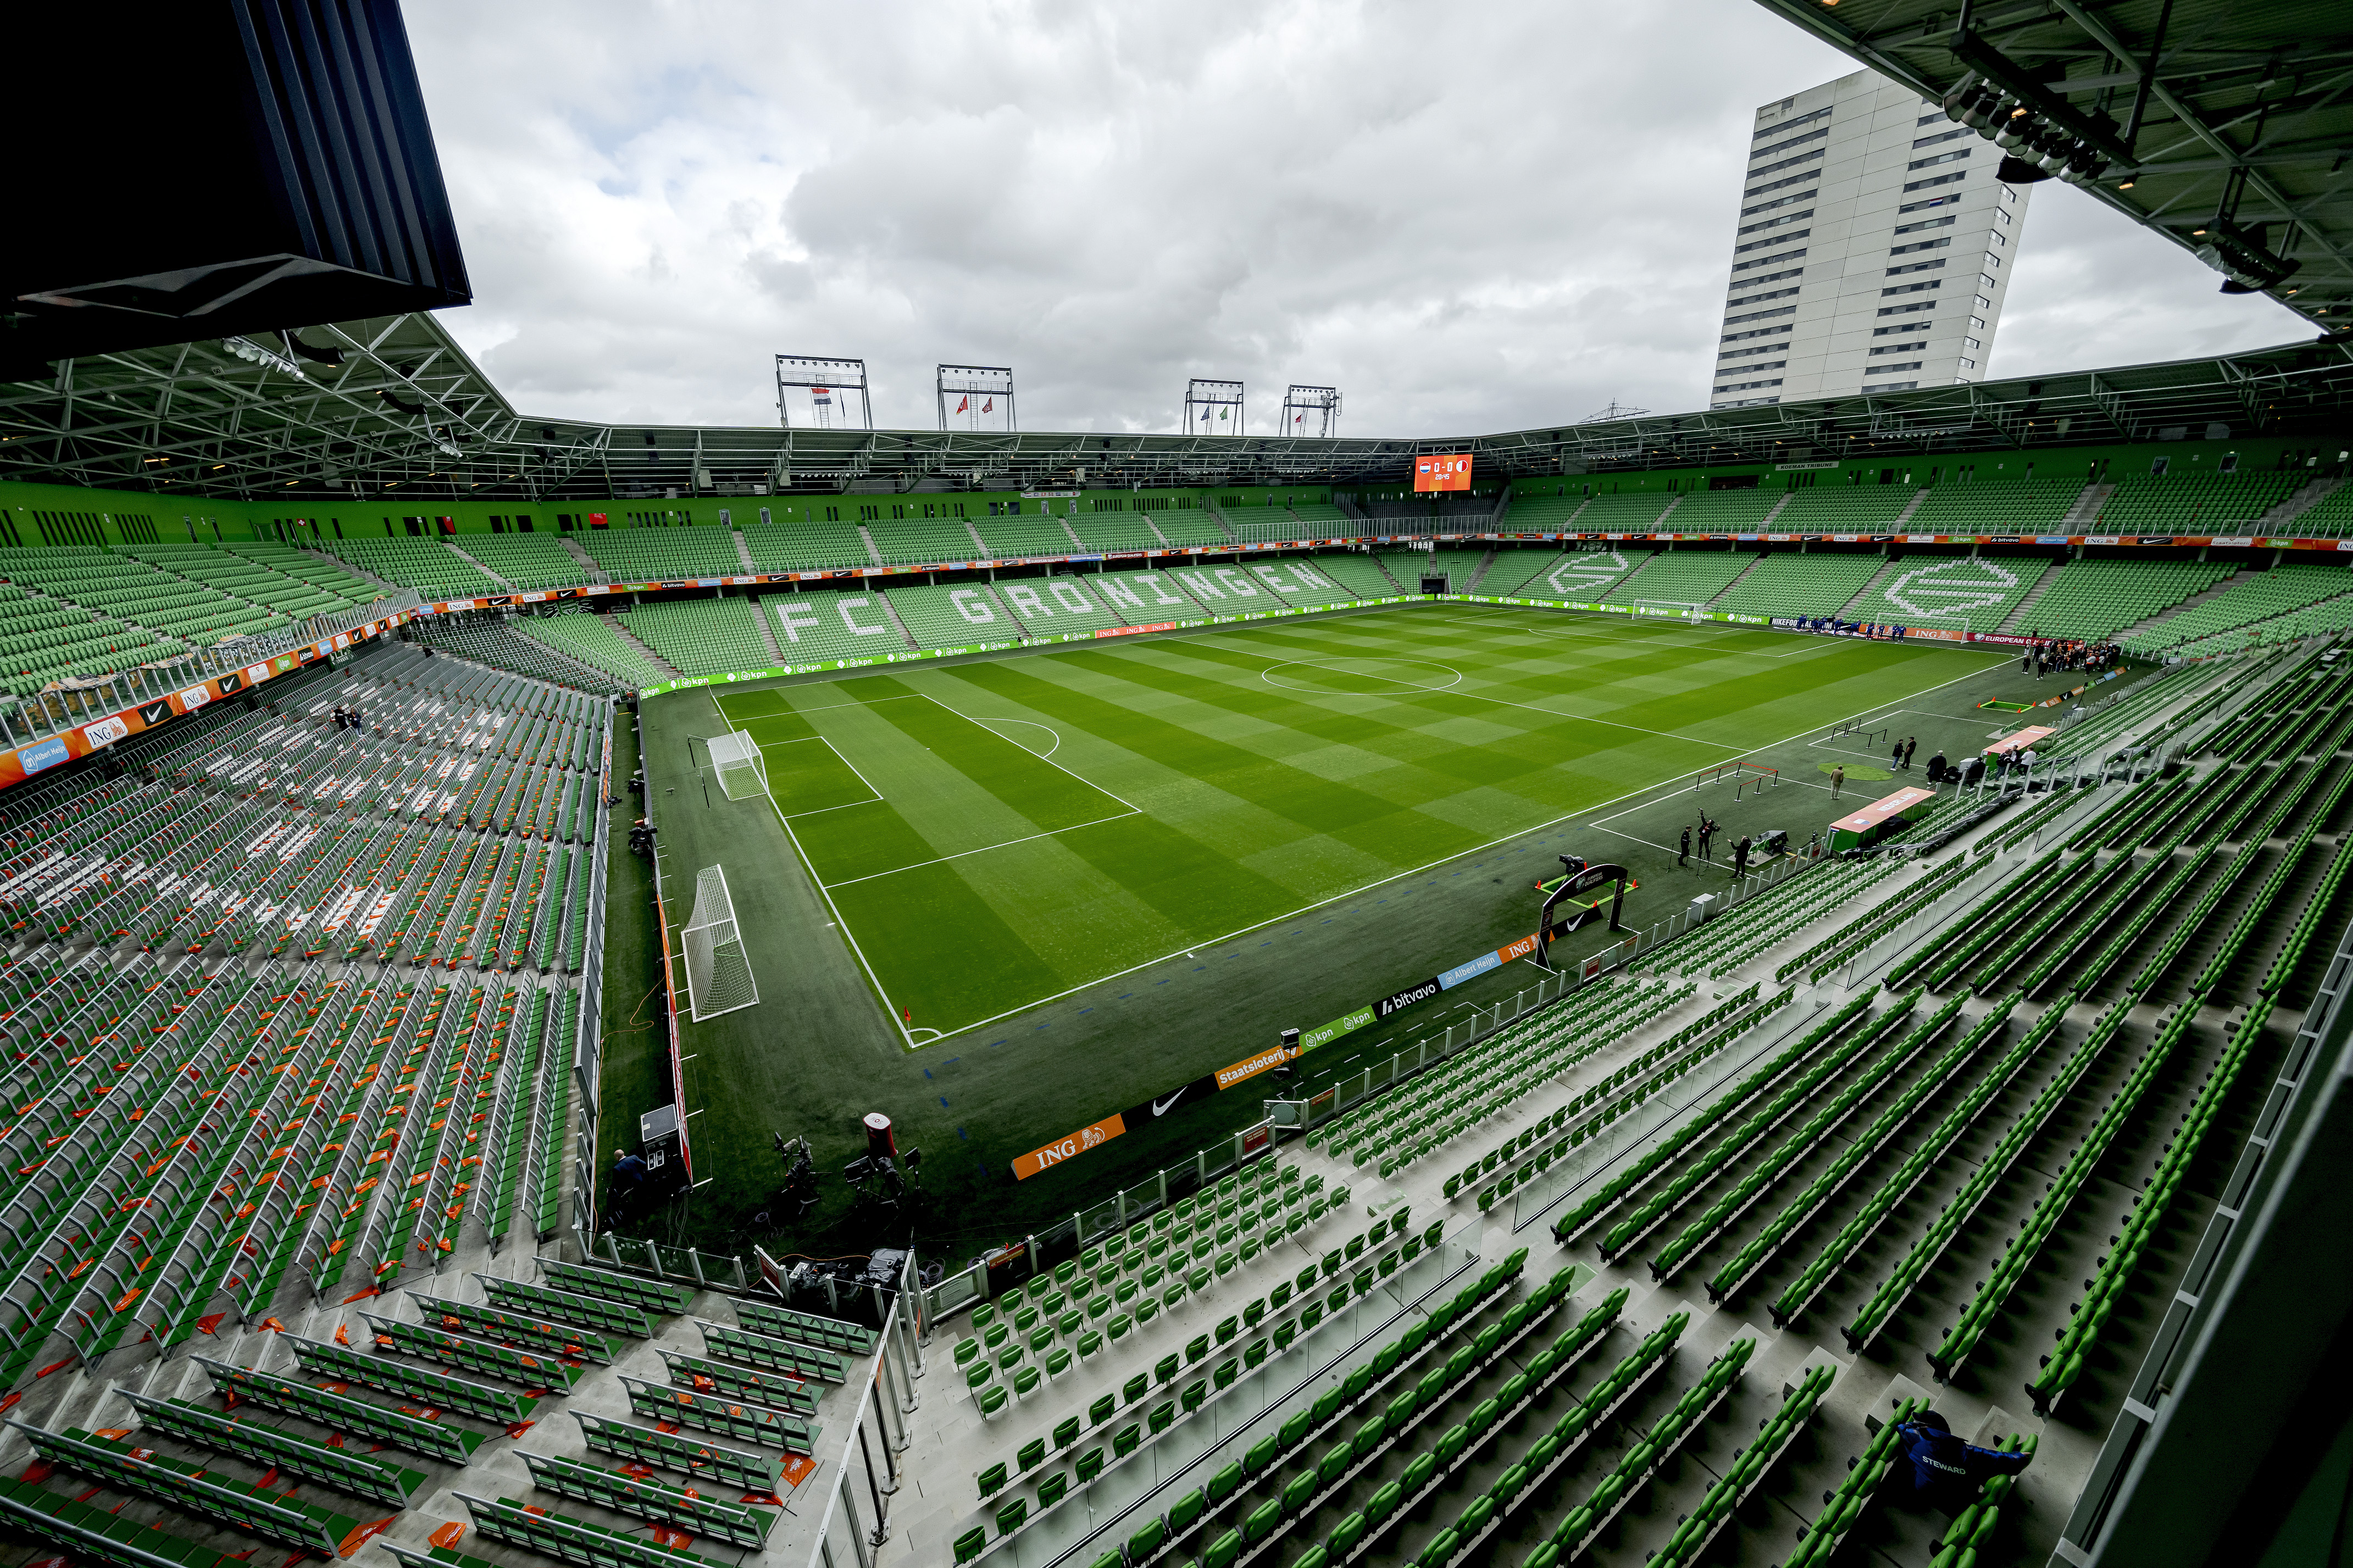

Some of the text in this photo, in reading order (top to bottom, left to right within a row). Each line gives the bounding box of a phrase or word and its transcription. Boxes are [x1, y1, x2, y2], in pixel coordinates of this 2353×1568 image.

[1434, 463, 1440, 472] 0
[1447, 462, 1453, 472] 0
[775, 563, 1331, 642] FC GRONINGEN
[1985, 636, 2024, 644] EUROPEAN
[692, 677, 709, 686] kpn
[647, 687, 659, 696] kpn
[184, 693, 199, 708] ING
[88, 727, 112, 746] ING
[35, 745, 66, 762] Albert Heijn
[1877, 793, 1918, 812] NEDERLAND
[1587, 871, 1602, 881] EUROPEAN
[1508, 941, 1530, 958] ING
[1455, 957, 1495, 979] Albert Heijn
[1392, 985, 1436, 1009] bitvavo
[1353, 1012, 1370, 1025] kpn
[1315, 1028, 1334, 1042] kpn
[1219, 1048, 1285, 1083] Staatsloterij
[870, 1116, 884, 1125] NOS
[1036, 1139, 1076, 1169] ING
[1922, 1456, 1966, 1475] STEWARD
